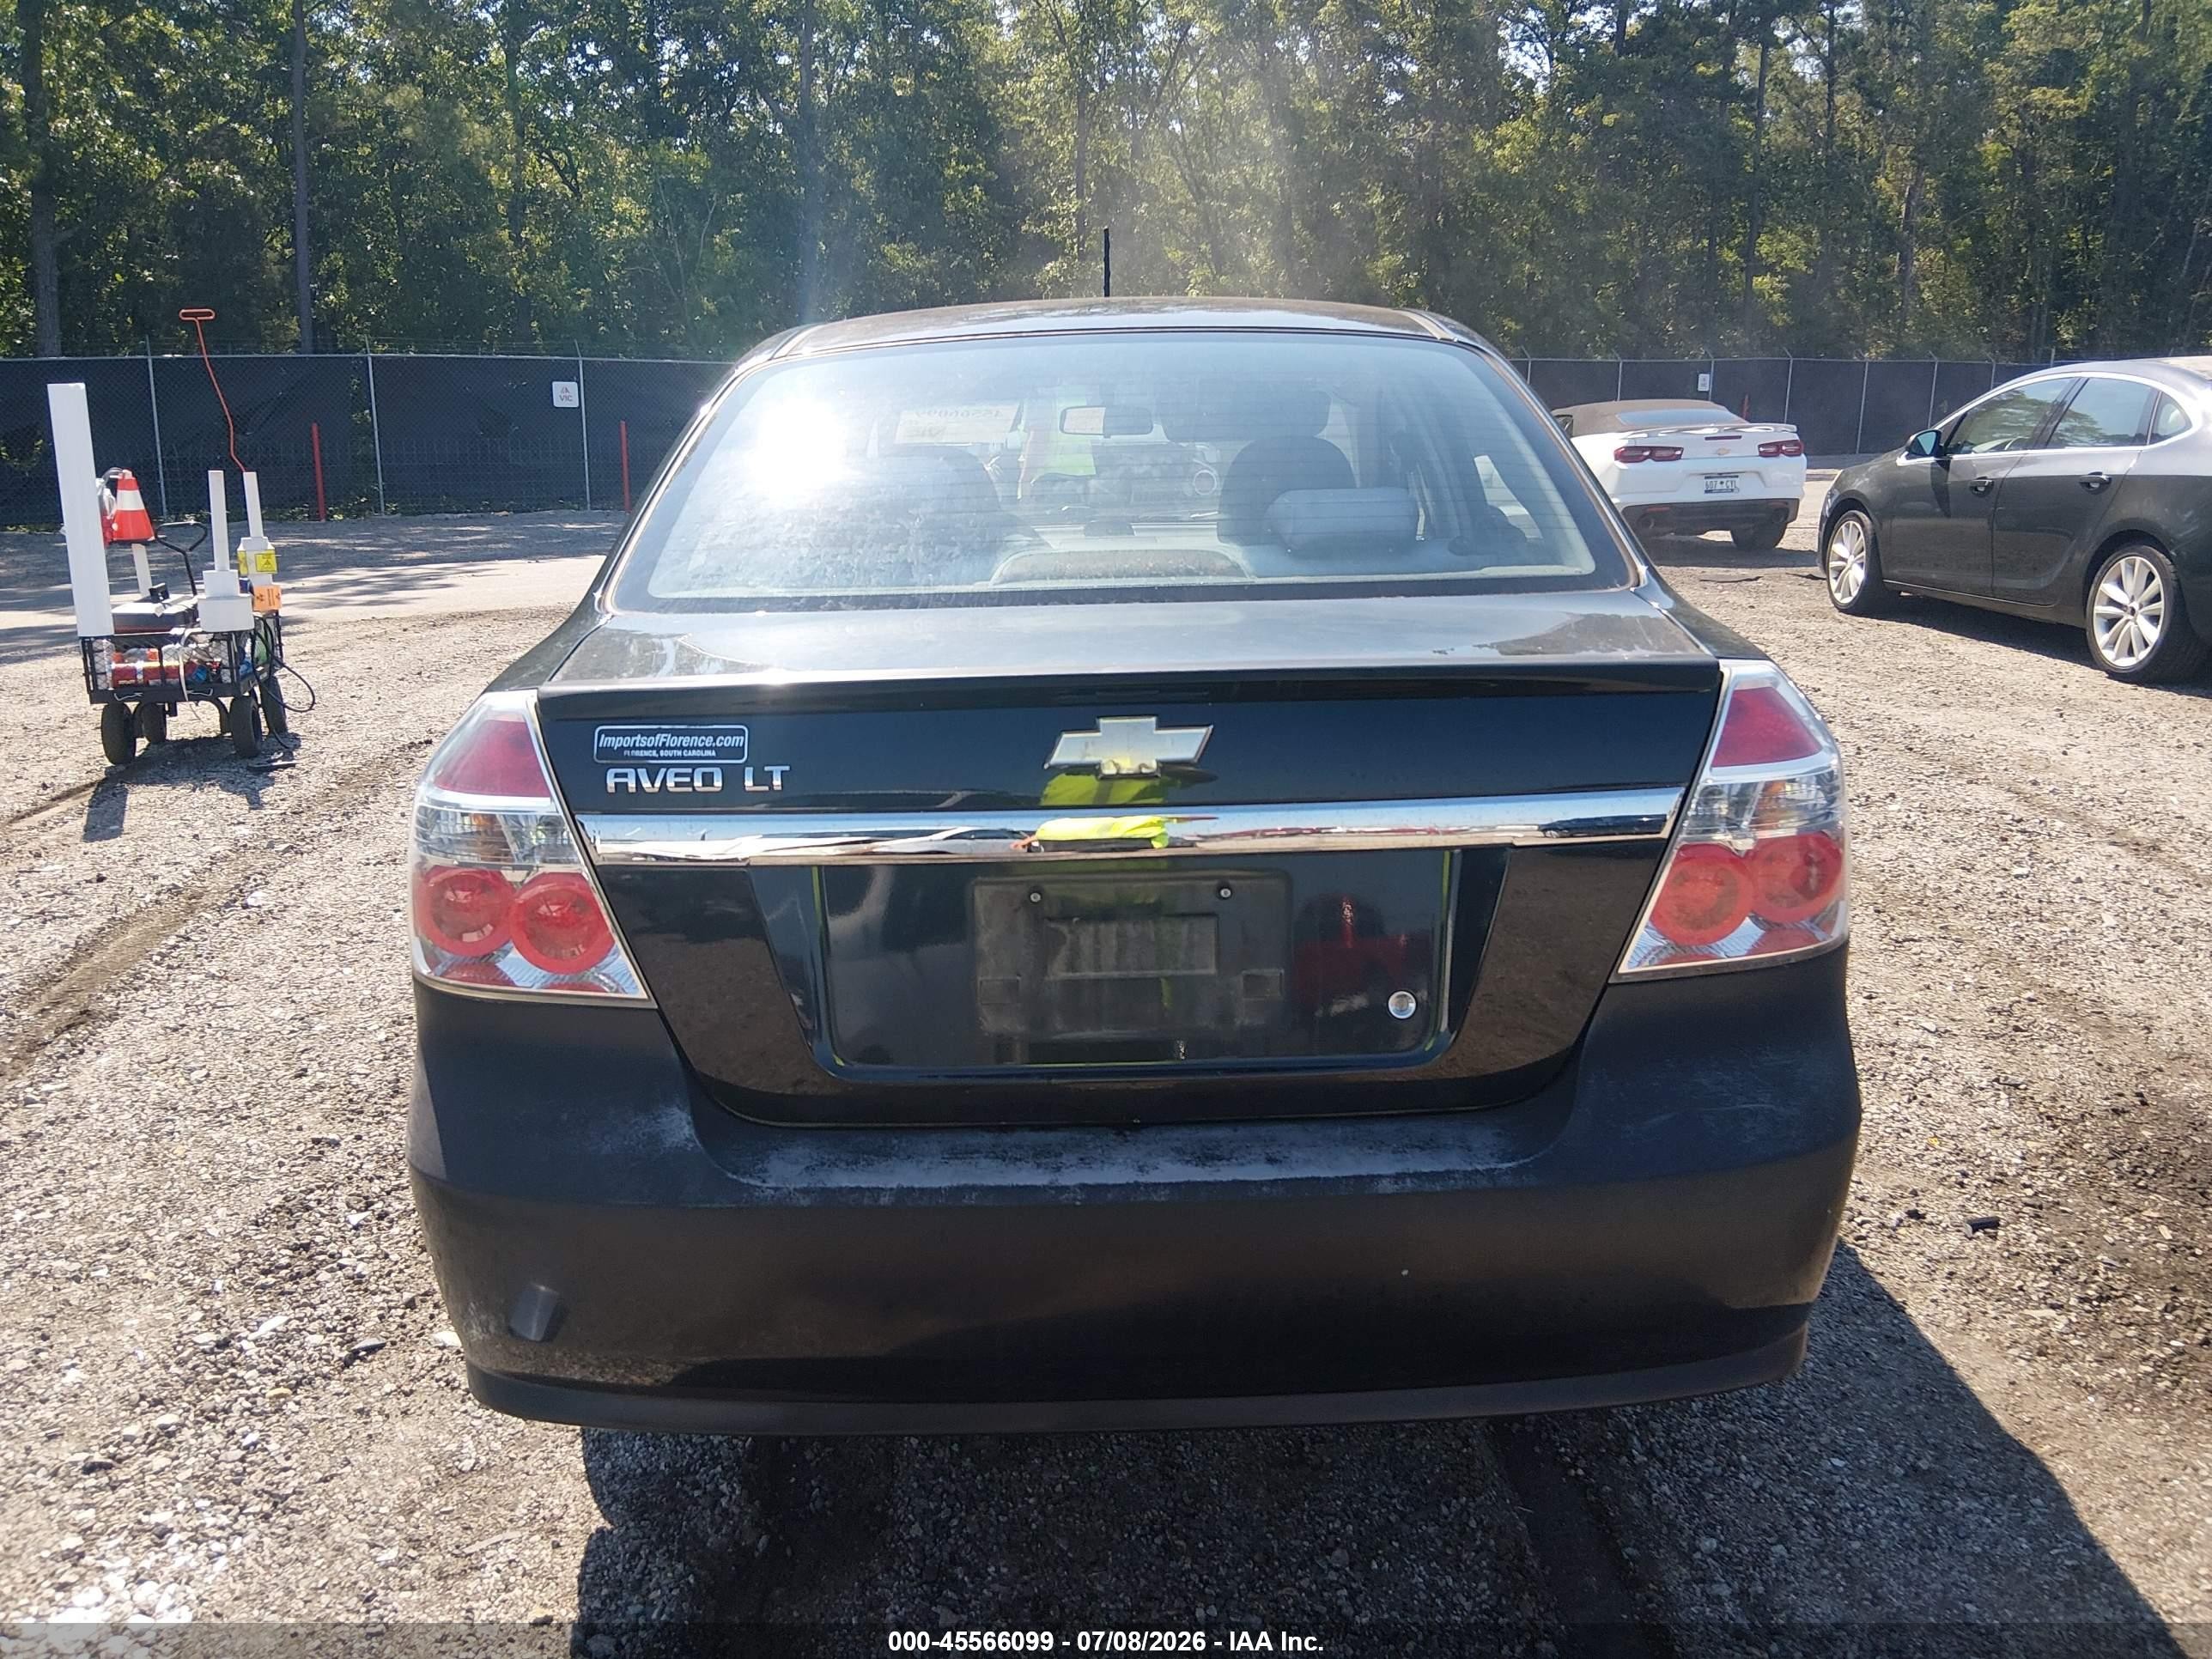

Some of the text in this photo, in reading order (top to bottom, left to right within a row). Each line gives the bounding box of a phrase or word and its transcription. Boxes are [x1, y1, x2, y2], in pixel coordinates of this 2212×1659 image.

[599, 733, 744, 750] ImportsofFlorence.com
[659, 749, 682, 757] SOUTH
[684, 749, 716, 757] CAROLINA
[606, 765, 790, 793] AVEO LT
